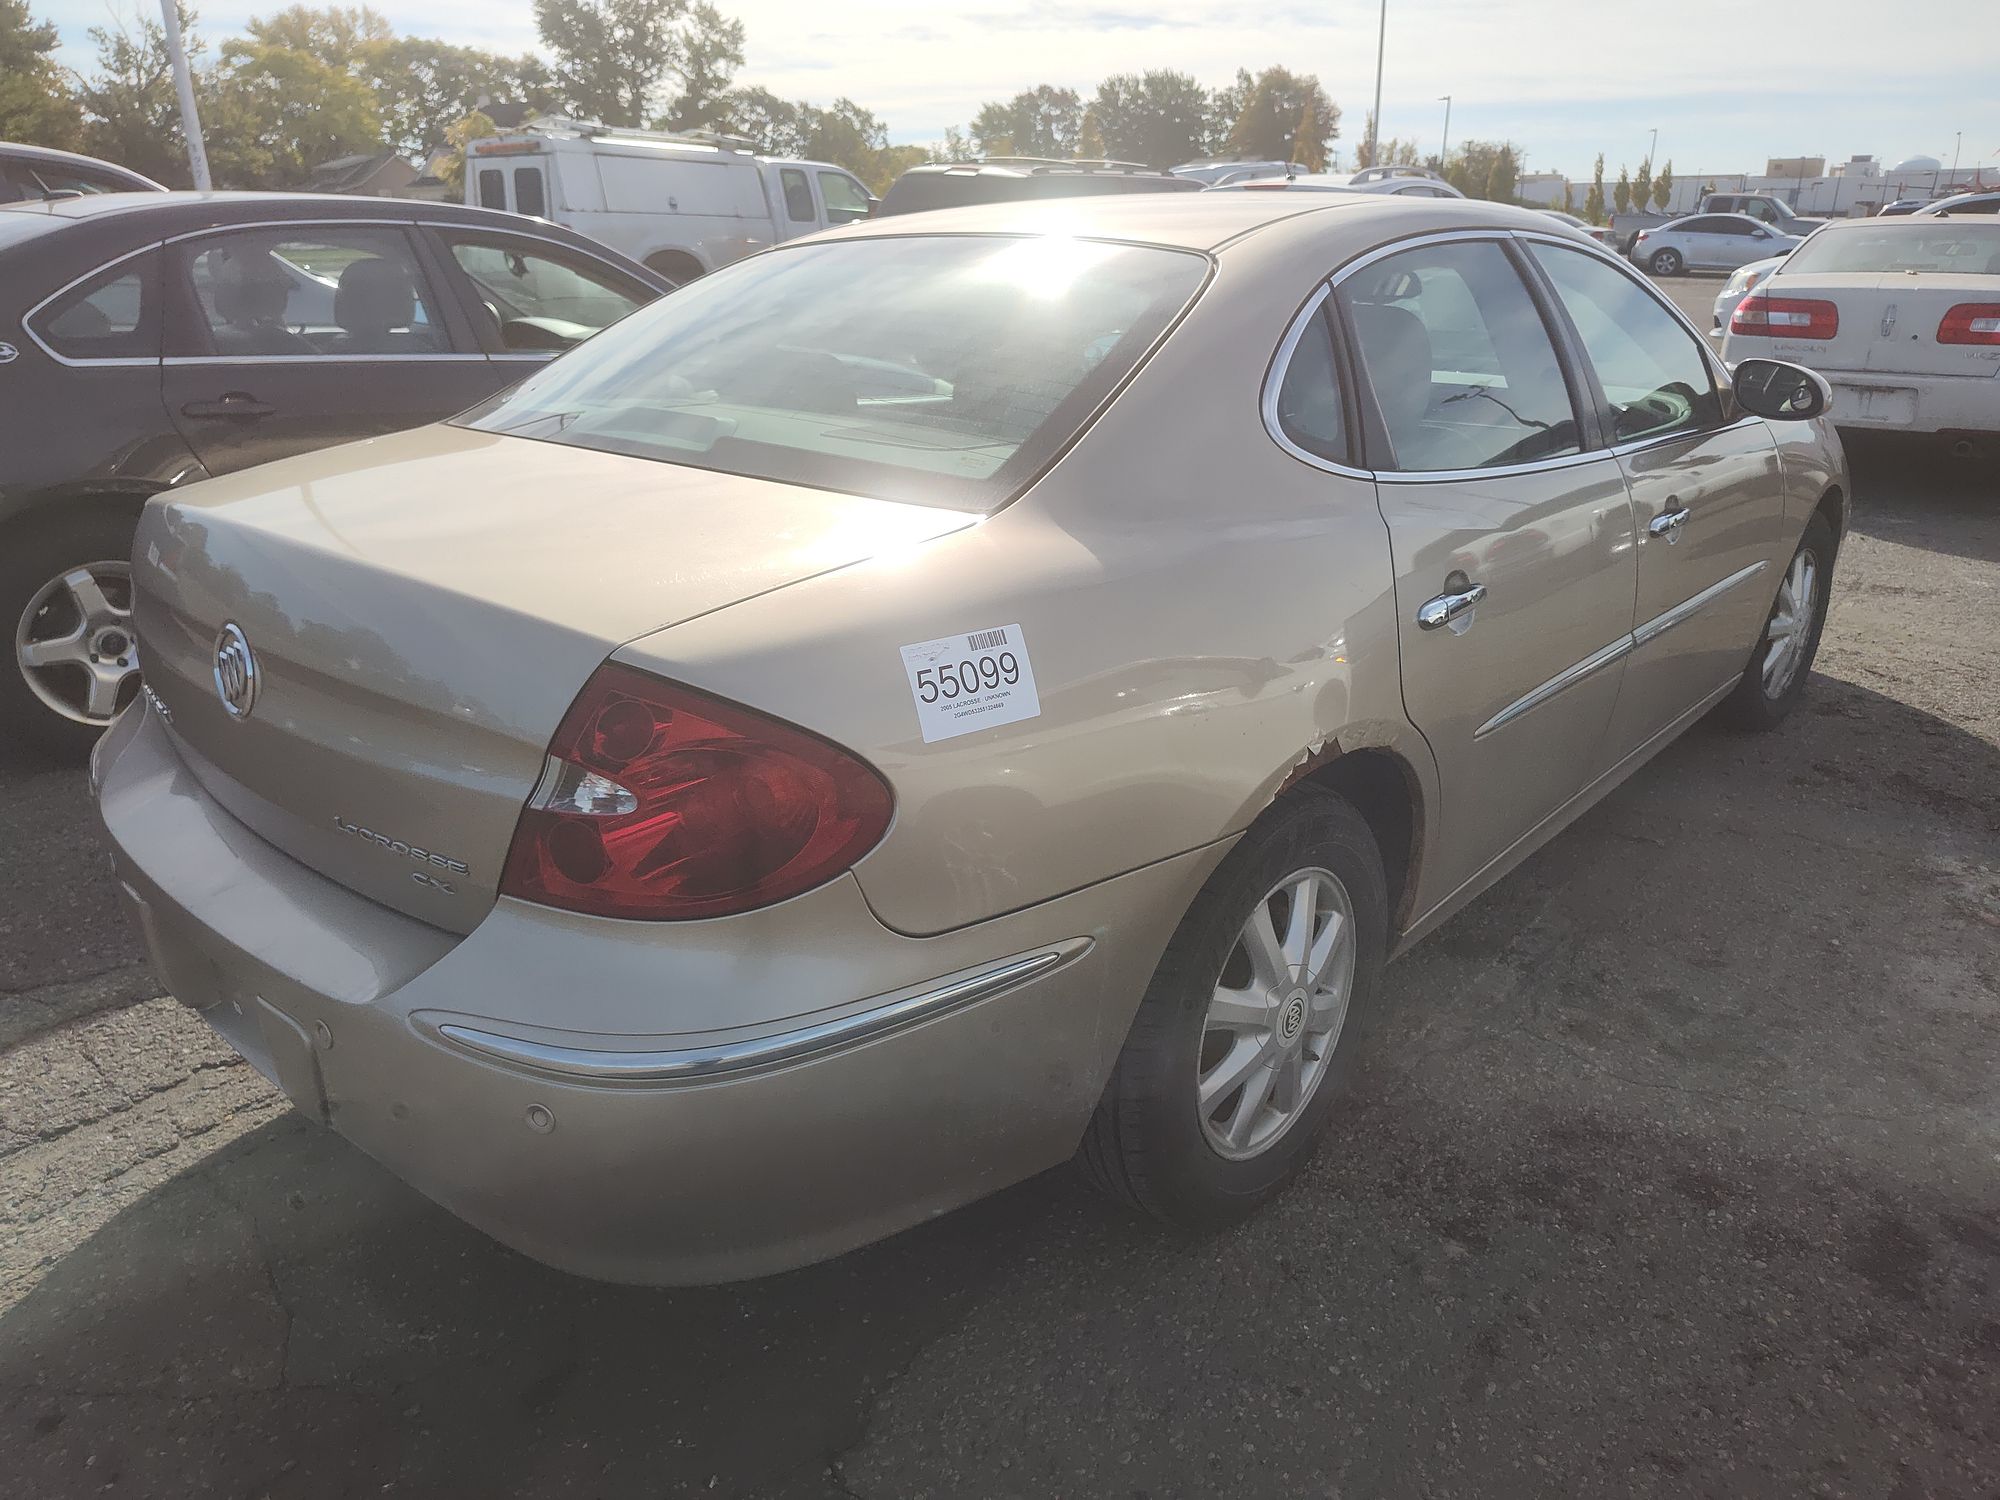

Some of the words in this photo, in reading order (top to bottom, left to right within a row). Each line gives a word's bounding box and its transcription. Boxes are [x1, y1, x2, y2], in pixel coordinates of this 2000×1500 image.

[917, 652, 1019, 704] 55099
[940, 704, 953, 712] 2005
[953, 697, 981, 709] LACROSSE
[984, 691, 1011, 702] UNKNOWN
[411, 871, 456, 895] CX
